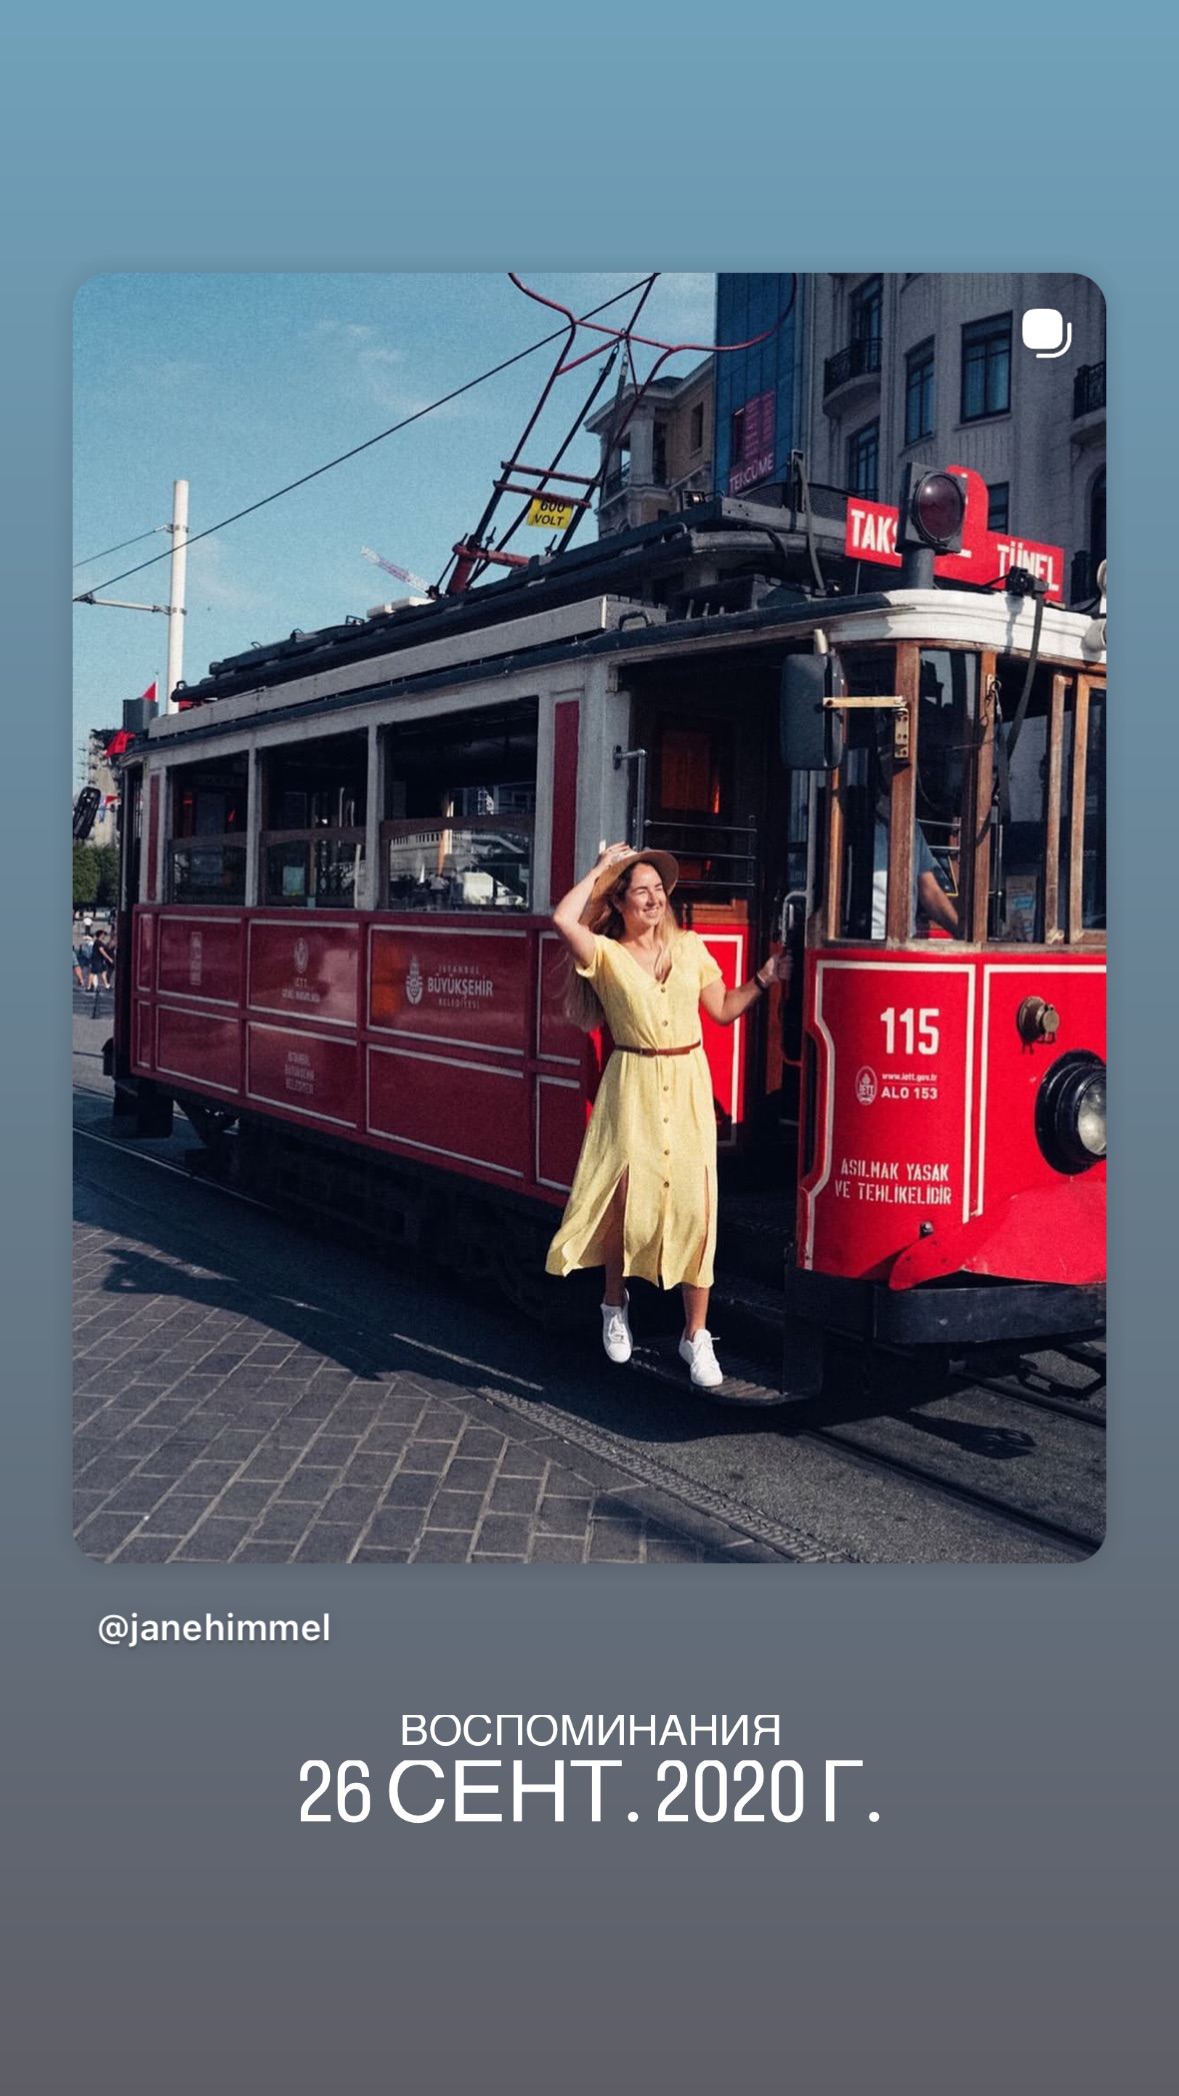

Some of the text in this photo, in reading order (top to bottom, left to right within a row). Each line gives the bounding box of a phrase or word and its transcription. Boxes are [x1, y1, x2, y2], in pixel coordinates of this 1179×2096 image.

[534, 513, 565, 526] VOLT
[427, 973, 494, 1000] BÜYÜKŞEHİR
[880, 1007, 940, 1055] 115
[881, 1086, 938, 1100] ALO 153
[841, 1158, 950, 1182] ASILMAK YASAK
[835, 1180, 952, 1205] VE TEHLİKELİDİR
